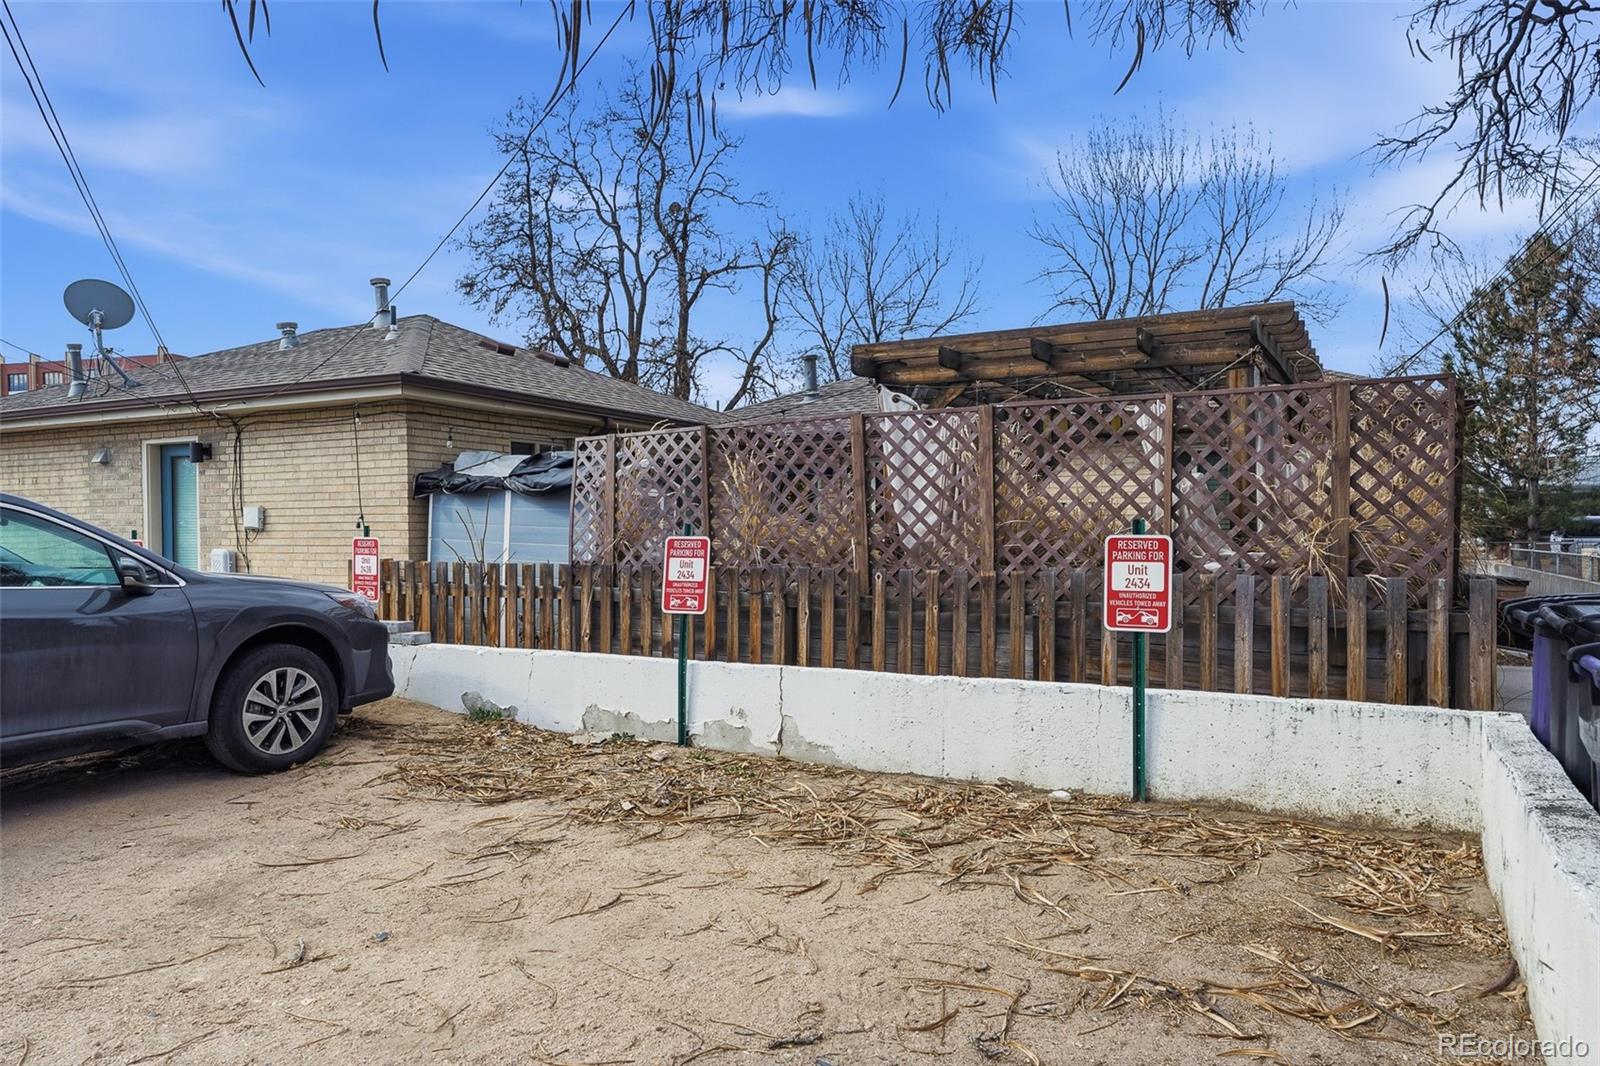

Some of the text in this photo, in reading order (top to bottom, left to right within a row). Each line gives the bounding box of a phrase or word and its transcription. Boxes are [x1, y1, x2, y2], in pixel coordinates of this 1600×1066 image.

[673, 540, 702, 548] RESERVED
[1117, 540, 1159, 550] RESERVED
[669, 549, 705, 557] PARKING FOR
[1112, 551, 1164, 561] PARKING FOR
[679, 559, 694, 569] Unit
[676, 570, 695, 580] 2434
[1127, 564, 1148, 576] Unit
[1124, 577, 1150, 589] 2434
